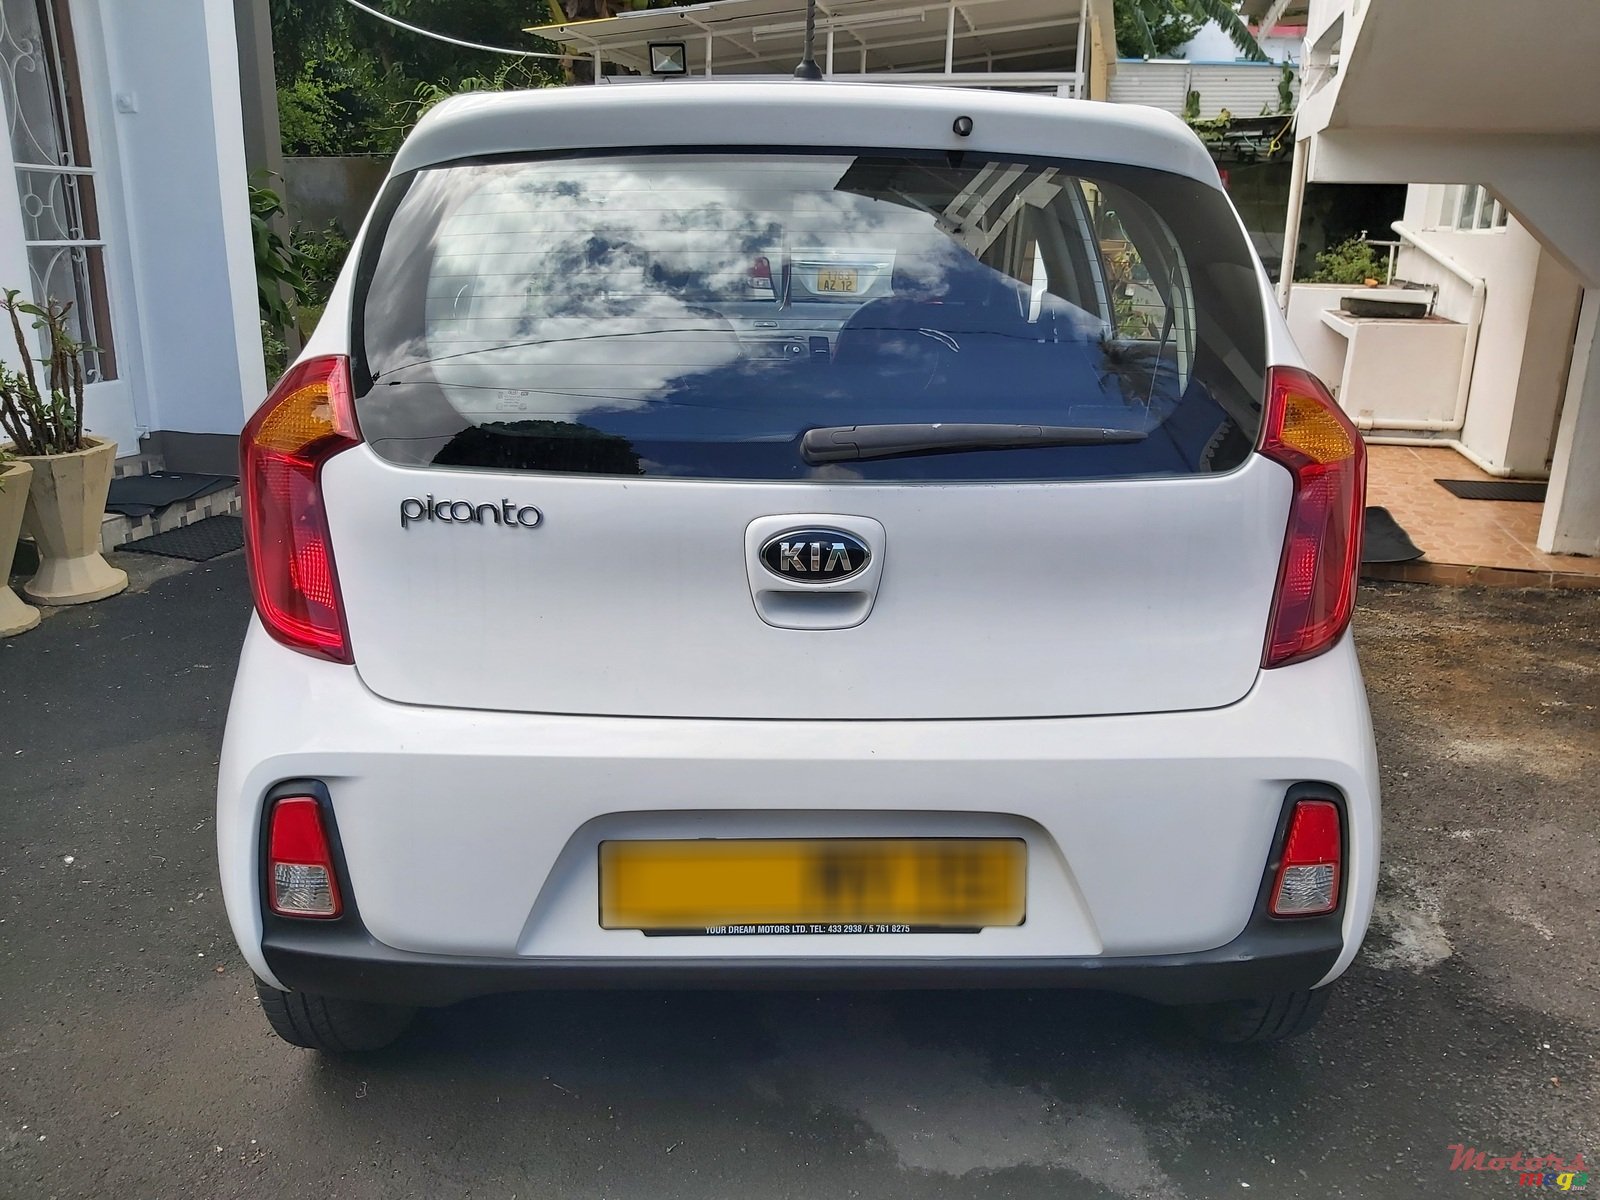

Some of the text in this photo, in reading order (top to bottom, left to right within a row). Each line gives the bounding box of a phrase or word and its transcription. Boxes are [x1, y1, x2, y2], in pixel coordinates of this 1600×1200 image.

[824, 280, 852, 291] AZ 12
[400, 492, 544, 528] picanto
[780, 542, 852, 572] KIA
[705, 925, 727, 934] YOUR
[728, 925, 756, 934] DREAM
[757, 925, 790, 934] MOTORS
[791, 924, 808, 933] LTD.
[809, 924, 826, 933] TEL:
[827, 924, 842, 933] 433
[843, 924, 862, 933] 2938
[876, 924, 889, 933] 761
[891, 924, 910, 933] 8275
